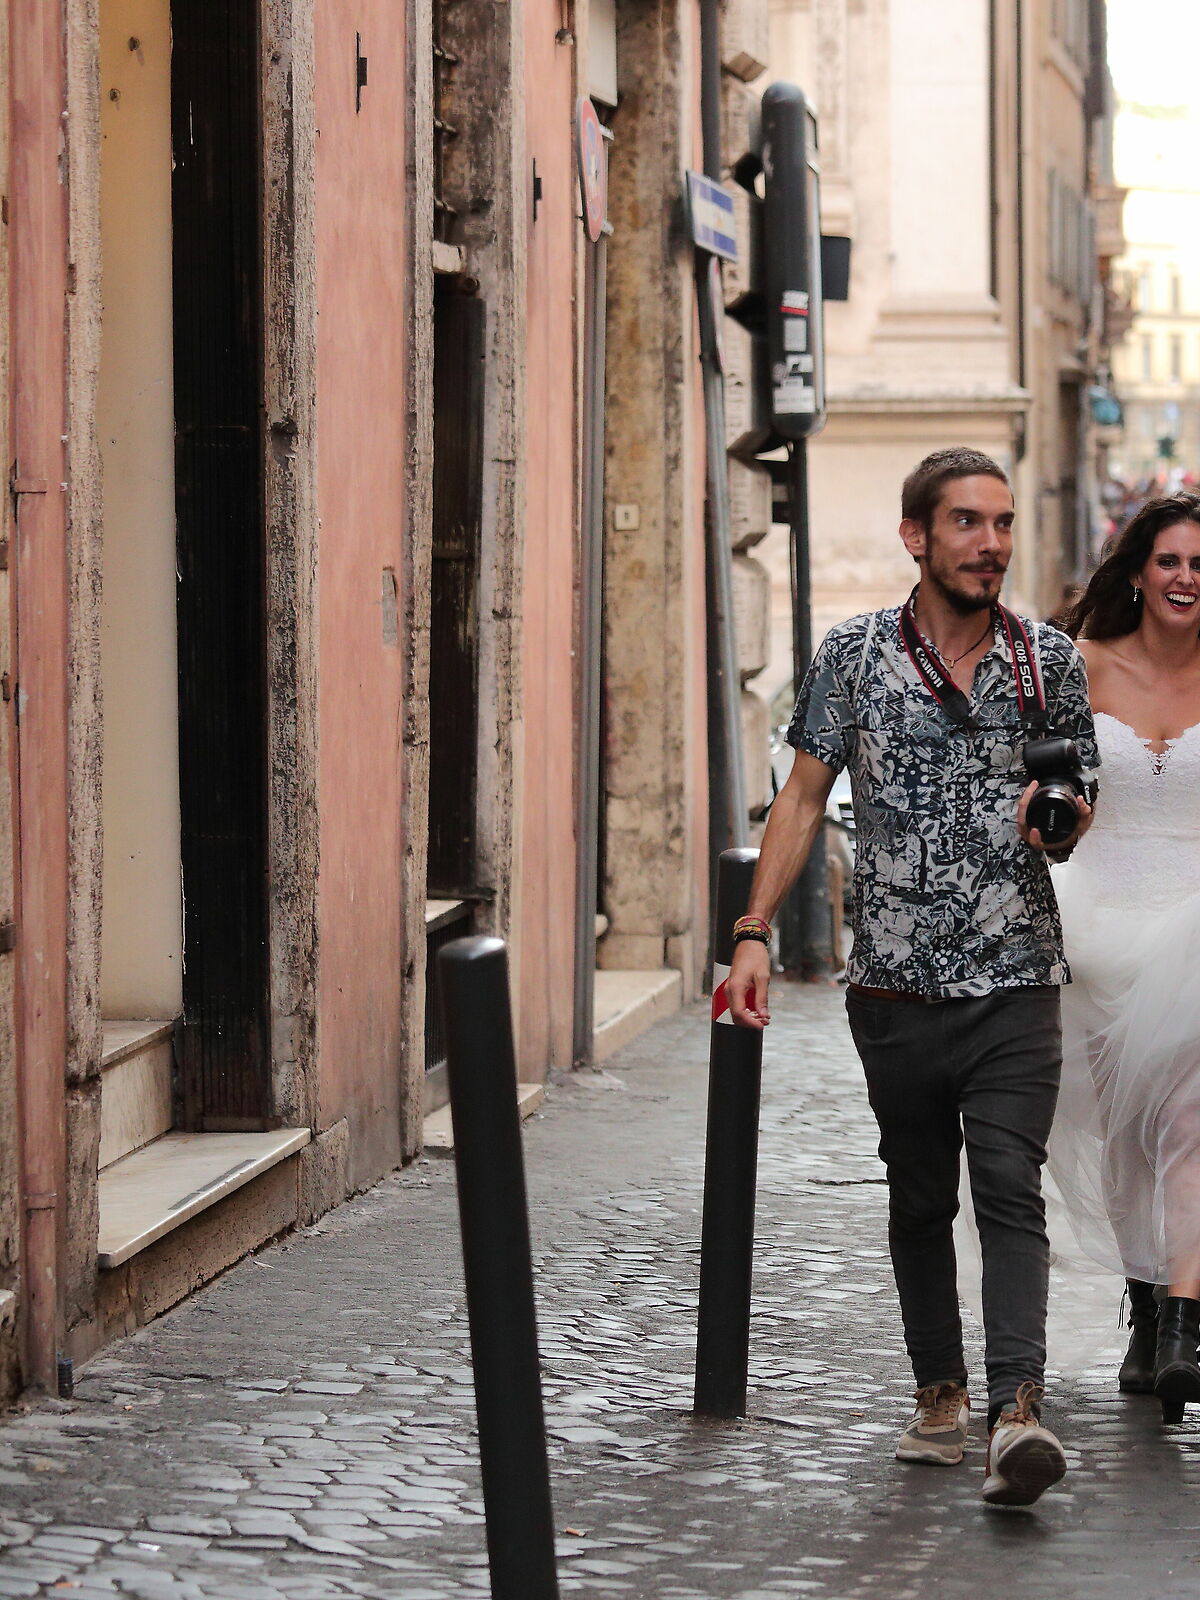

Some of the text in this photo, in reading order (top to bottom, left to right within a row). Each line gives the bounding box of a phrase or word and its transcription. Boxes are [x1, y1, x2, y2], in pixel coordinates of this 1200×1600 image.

[915, 647, 944, 688] Canon
[1014, 640, 1035, 697] EOS 80D
